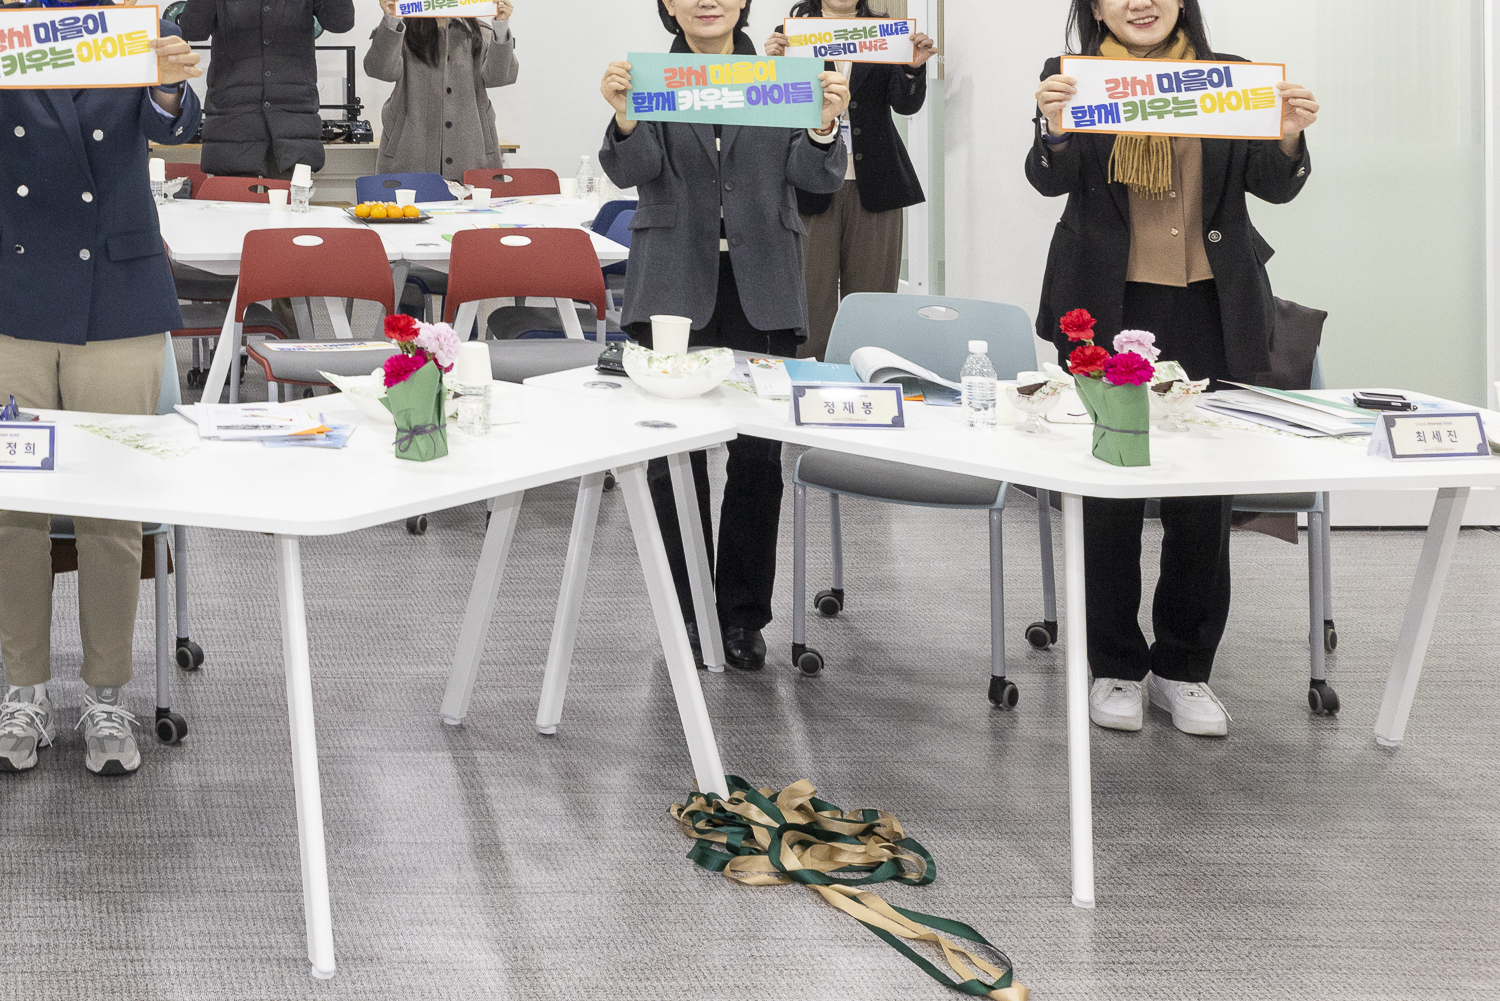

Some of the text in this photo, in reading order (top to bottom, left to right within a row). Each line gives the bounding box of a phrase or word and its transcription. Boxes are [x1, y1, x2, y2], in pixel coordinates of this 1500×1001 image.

[399, 1, 423, 16] 함께
[33, 11, 108, 44] 마을이
[789, 21, 910, 47] 함께 키우는 아이들
[2, 46, 75, 77] 키우는
[76, 30, 151, 63] 아이들
[813, 38, 888, 58] 강서 마을이
[663, 60, 777, 89] 강서 마을이
[1105, 66, 1233, 100] 강서 마을이
[632, 81, 814, 113] 함께 키우는 아이들
[1071, 86, 1276, 128] 함께 키우는 아이들
